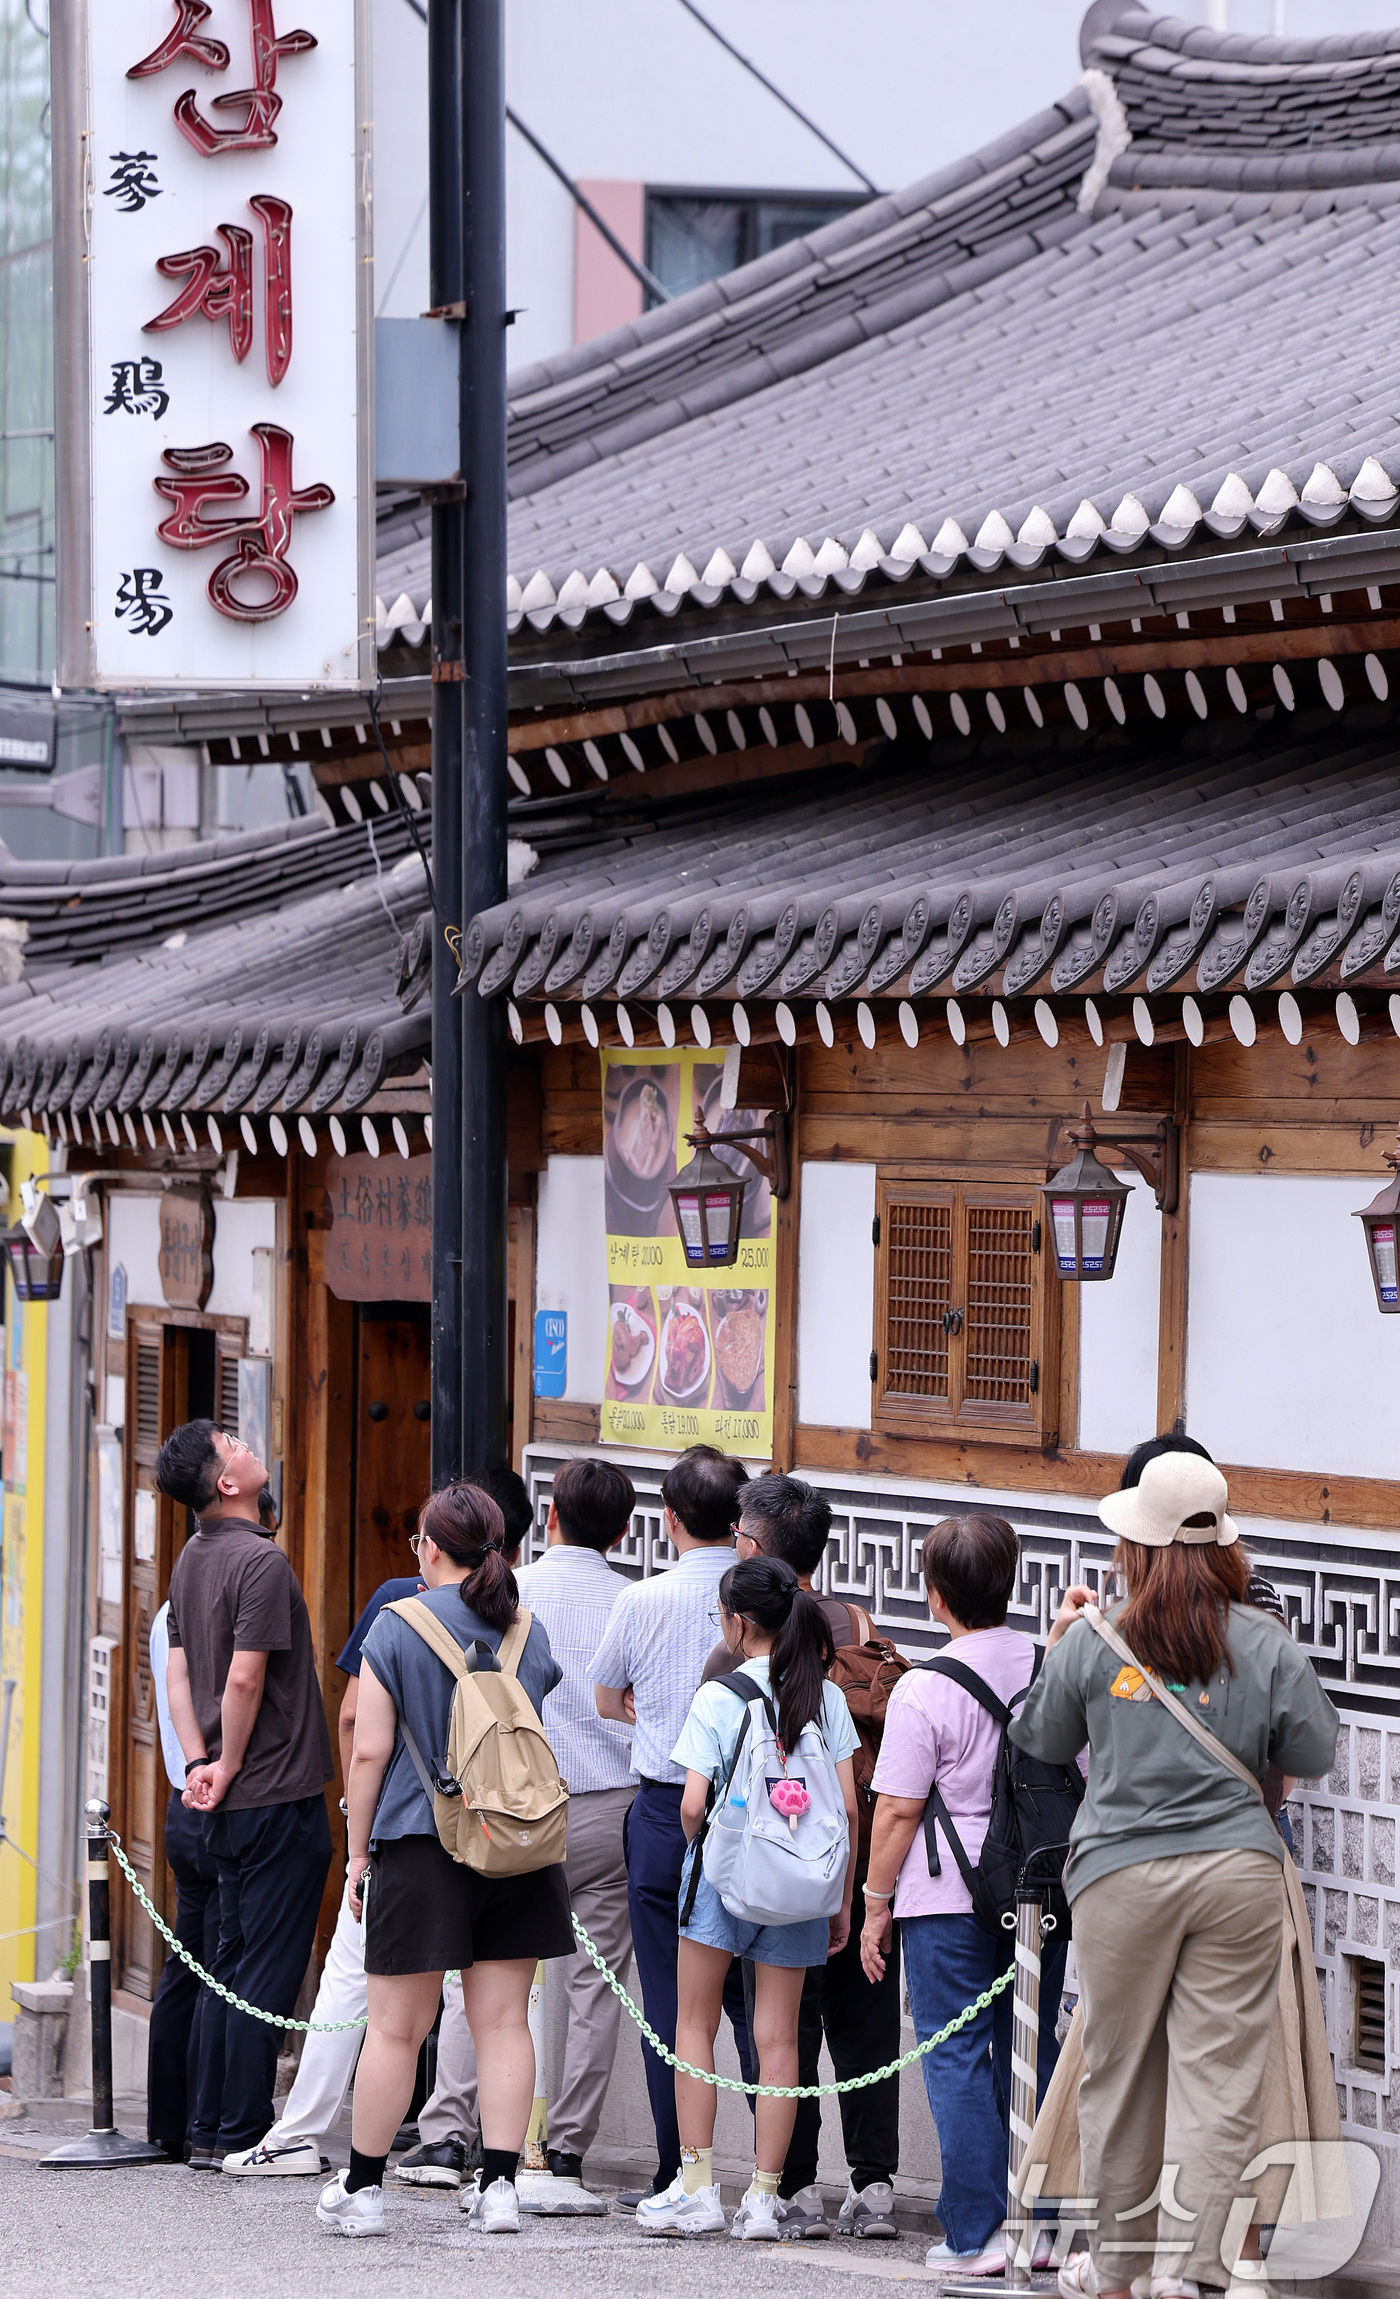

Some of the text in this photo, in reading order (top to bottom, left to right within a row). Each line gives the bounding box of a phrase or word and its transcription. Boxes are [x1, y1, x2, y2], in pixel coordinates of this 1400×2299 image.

[126, 0, 335, 622] 삼계탕
[610, 1241, 639, 1267] 삼계탕
[545, 1318, 565, 1338] CESCO
[677, 1414, 699, 1436] 19,000
[733, 1419, 760, 1440] 17,000
